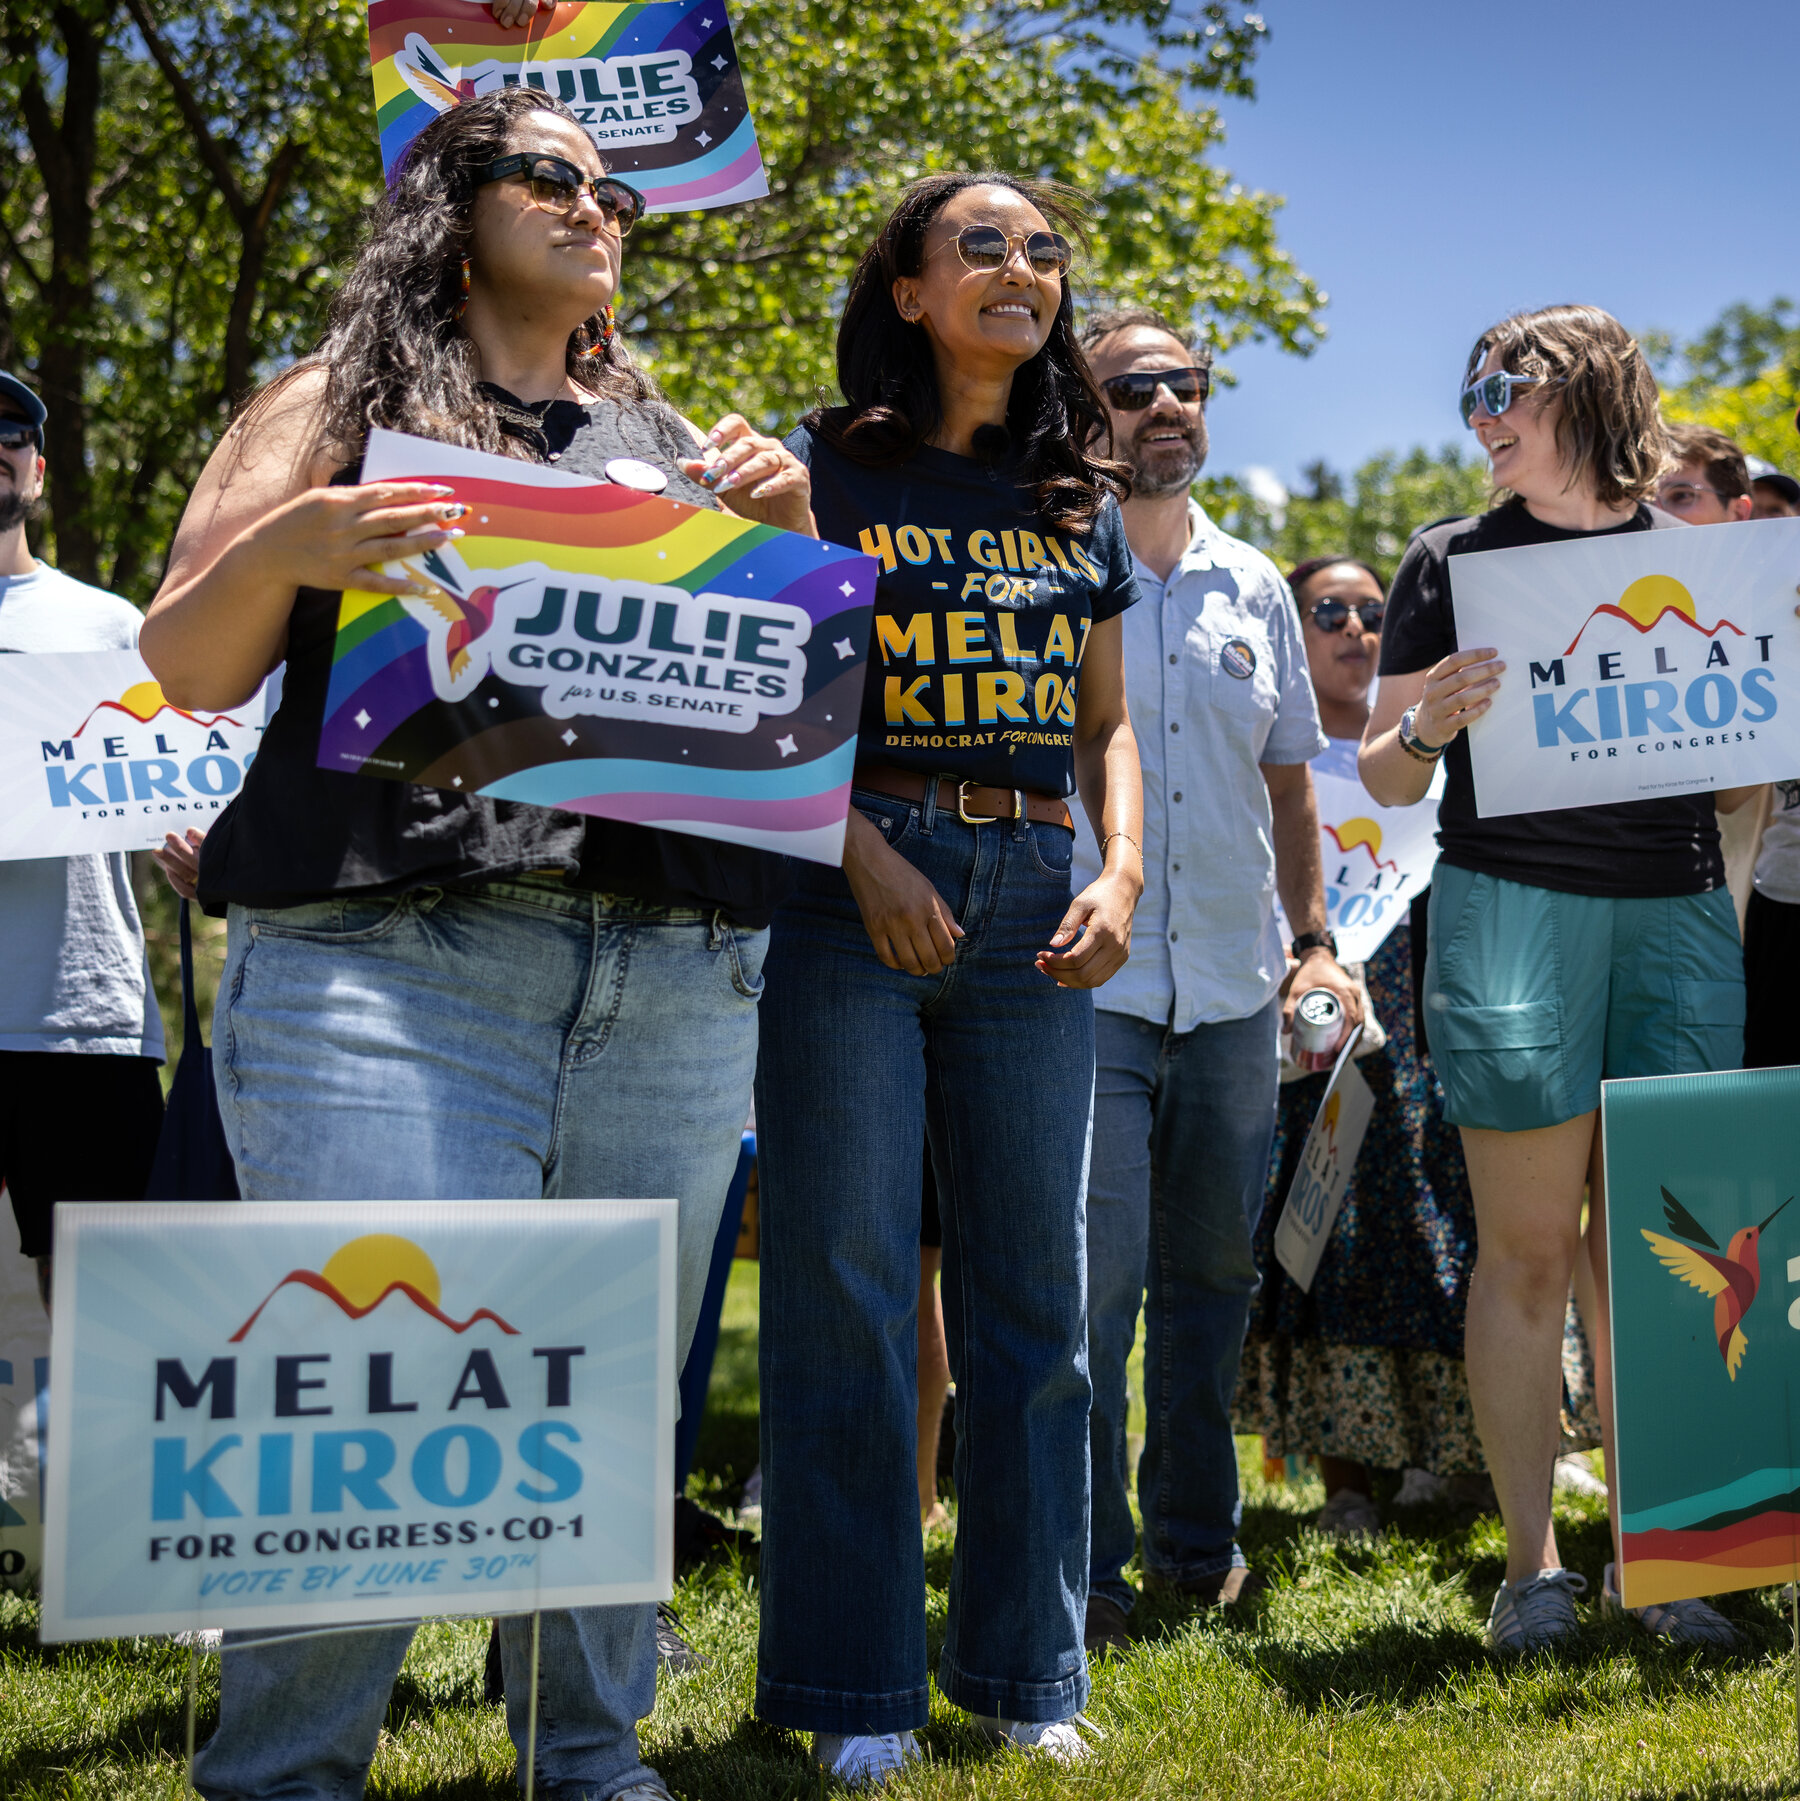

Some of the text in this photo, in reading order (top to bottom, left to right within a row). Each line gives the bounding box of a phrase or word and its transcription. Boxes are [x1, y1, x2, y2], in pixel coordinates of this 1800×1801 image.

[574, 98, 690, 124] ZALES
[598, 124, 665, 138] SENATE
[858, 524, 1100, 587] HOT GIRLS
[960, 572, 1037, 603] FOR
[508, 643, 787, 698] GONZALES
[1529, 635, 1774, 688] MELAT
[560, 684, 743, 716] for U.S. SENATE
[884, 671, 1076, 727] KIROS
[1532, 667, 1778, 748] KIROS
[885, 730, 1073, 748] DEMOCRAT FOR CONGRE
[1571, 730, 1755, 761] FOR CONGRESS
[82, 801, 231, 819] FOR CONGR
[1335, 866, 1411, 890] LAT
[1307, 1136, 1340, 1192] ELAT
[155, 1346, 586, 1421] MELAT
[151, 1420, 585, 1521] KIROS
[149, 1533, 235, 1561] FOR
[200, 1567, 292, 1596] VOTE
[300, 1563, 353, 1591] BY
[354, 1558, 448, 1587] JUNE
